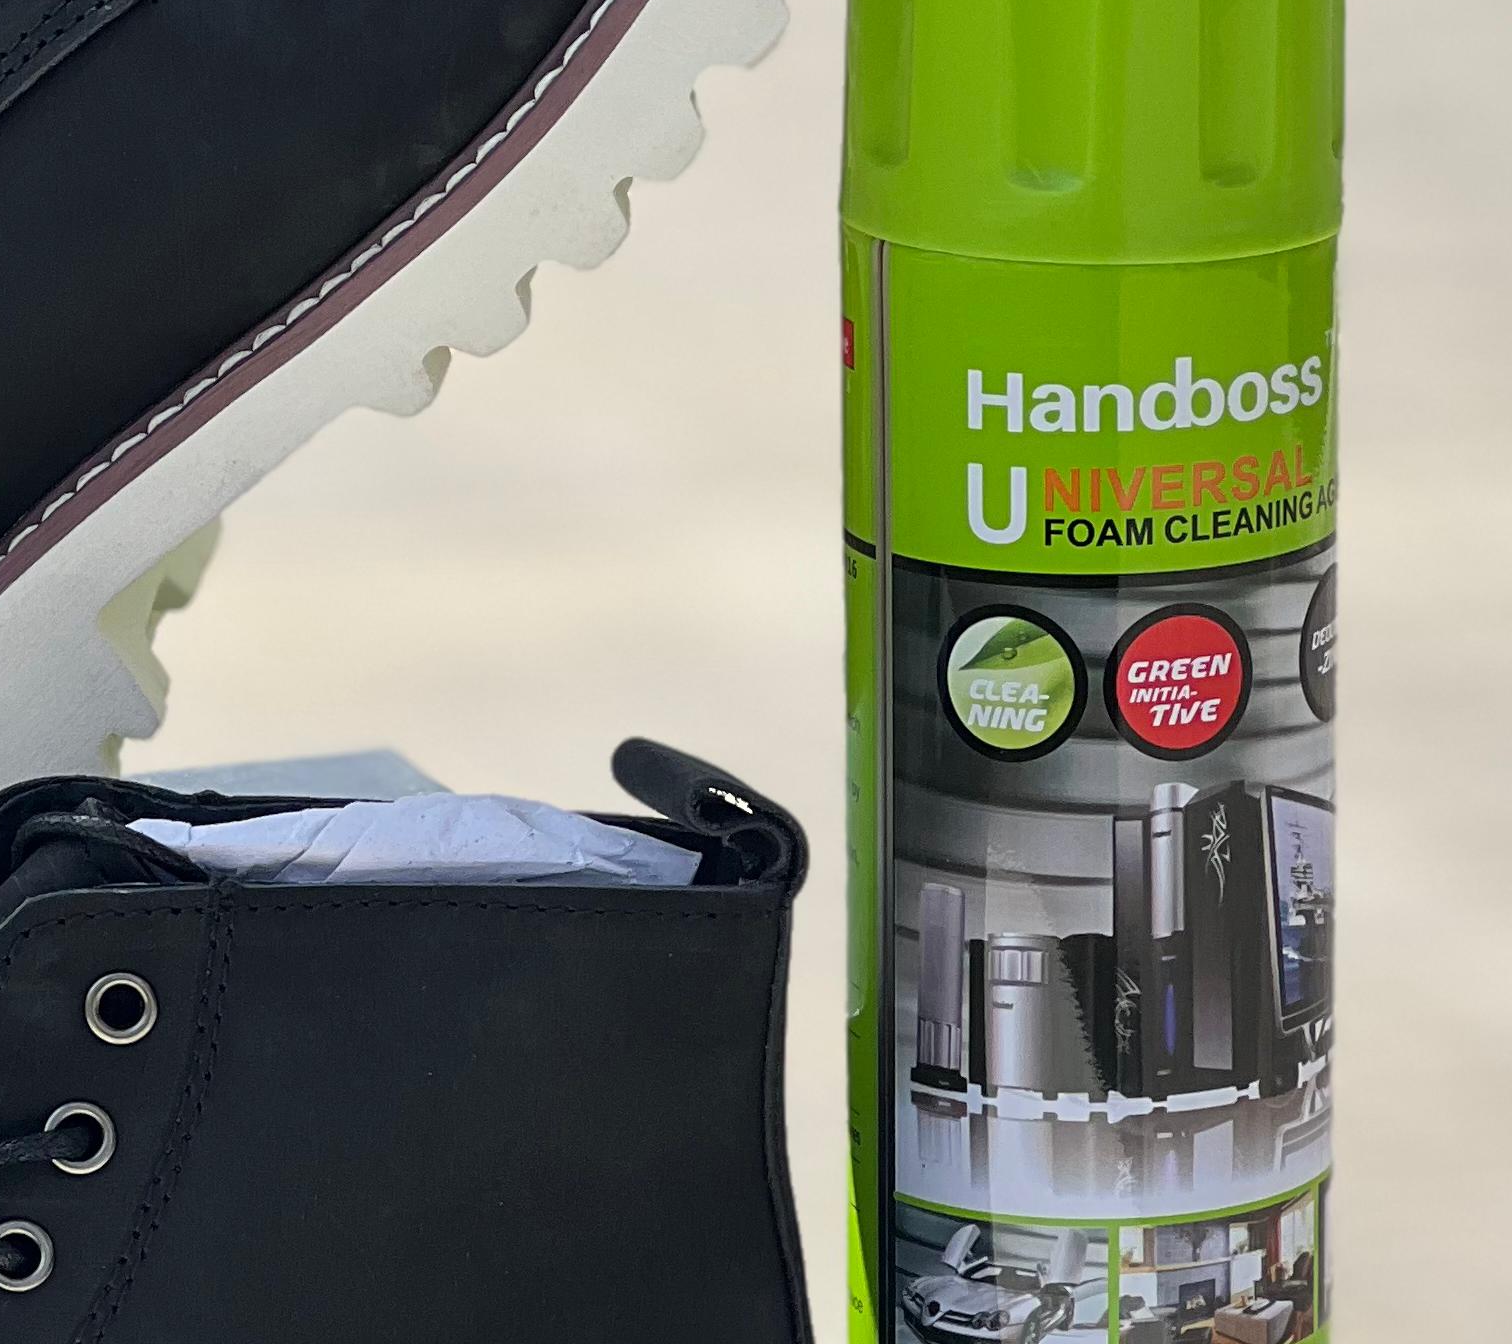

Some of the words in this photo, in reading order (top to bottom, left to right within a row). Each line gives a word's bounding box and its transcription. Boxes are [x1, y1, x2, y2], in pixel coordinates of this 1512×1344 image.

[967, 356, 1323, 433] Handboss
[1044, 518, 1154, 547] FOAM
[1164, 490, 1313, 544] CLEANING
[1127, 652, 1233, 684] GREEN
[968, 678, 1050, 705] CLEA-
[1129, 684, 1198, 704] INITIA-
[967, 703, 1048, 733] NING
[1148, 698, 1221, 728] TIVE
